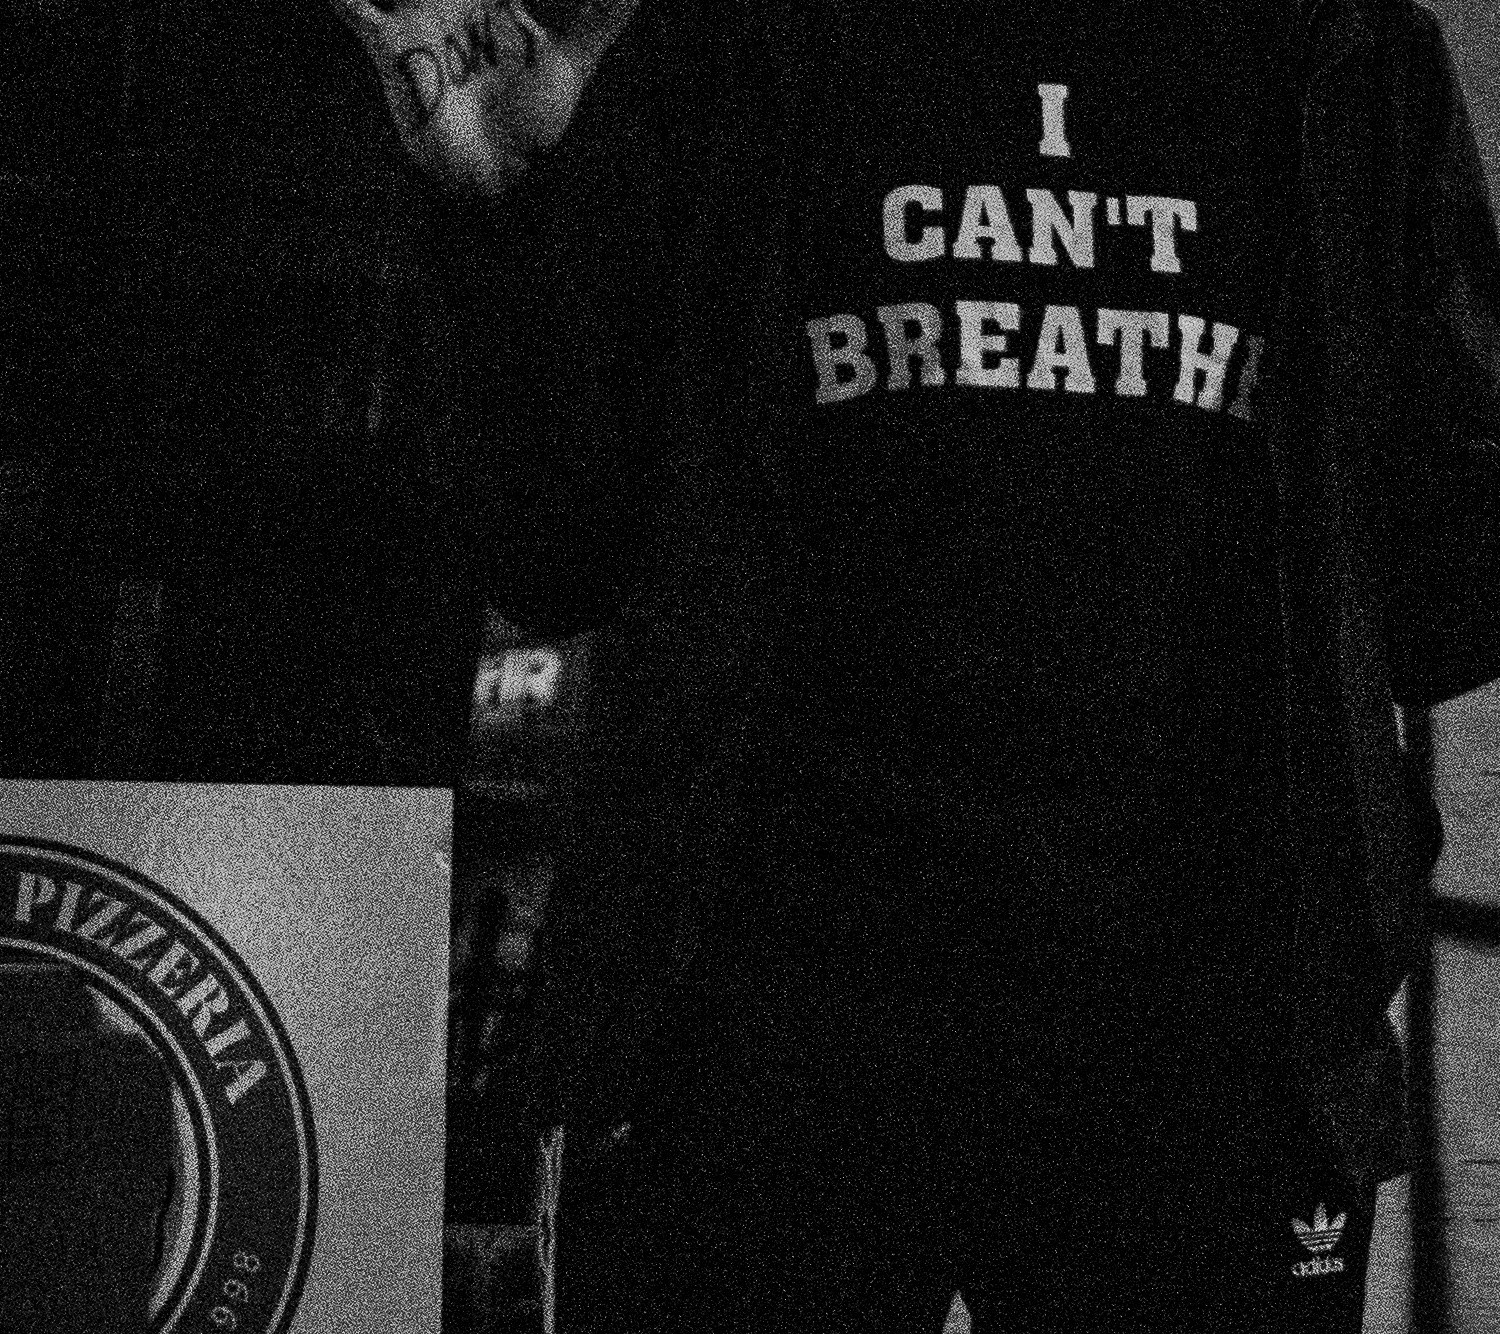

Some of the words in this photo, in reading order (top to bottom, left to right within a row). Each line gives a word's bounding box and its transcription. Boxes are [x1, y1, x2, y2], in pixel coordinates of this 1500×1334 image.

[1036, 82, 1072, 158] I
[882, 183, 1199, 274] CAN'T
[13, 871, 268, 1107] PIZZERIA
